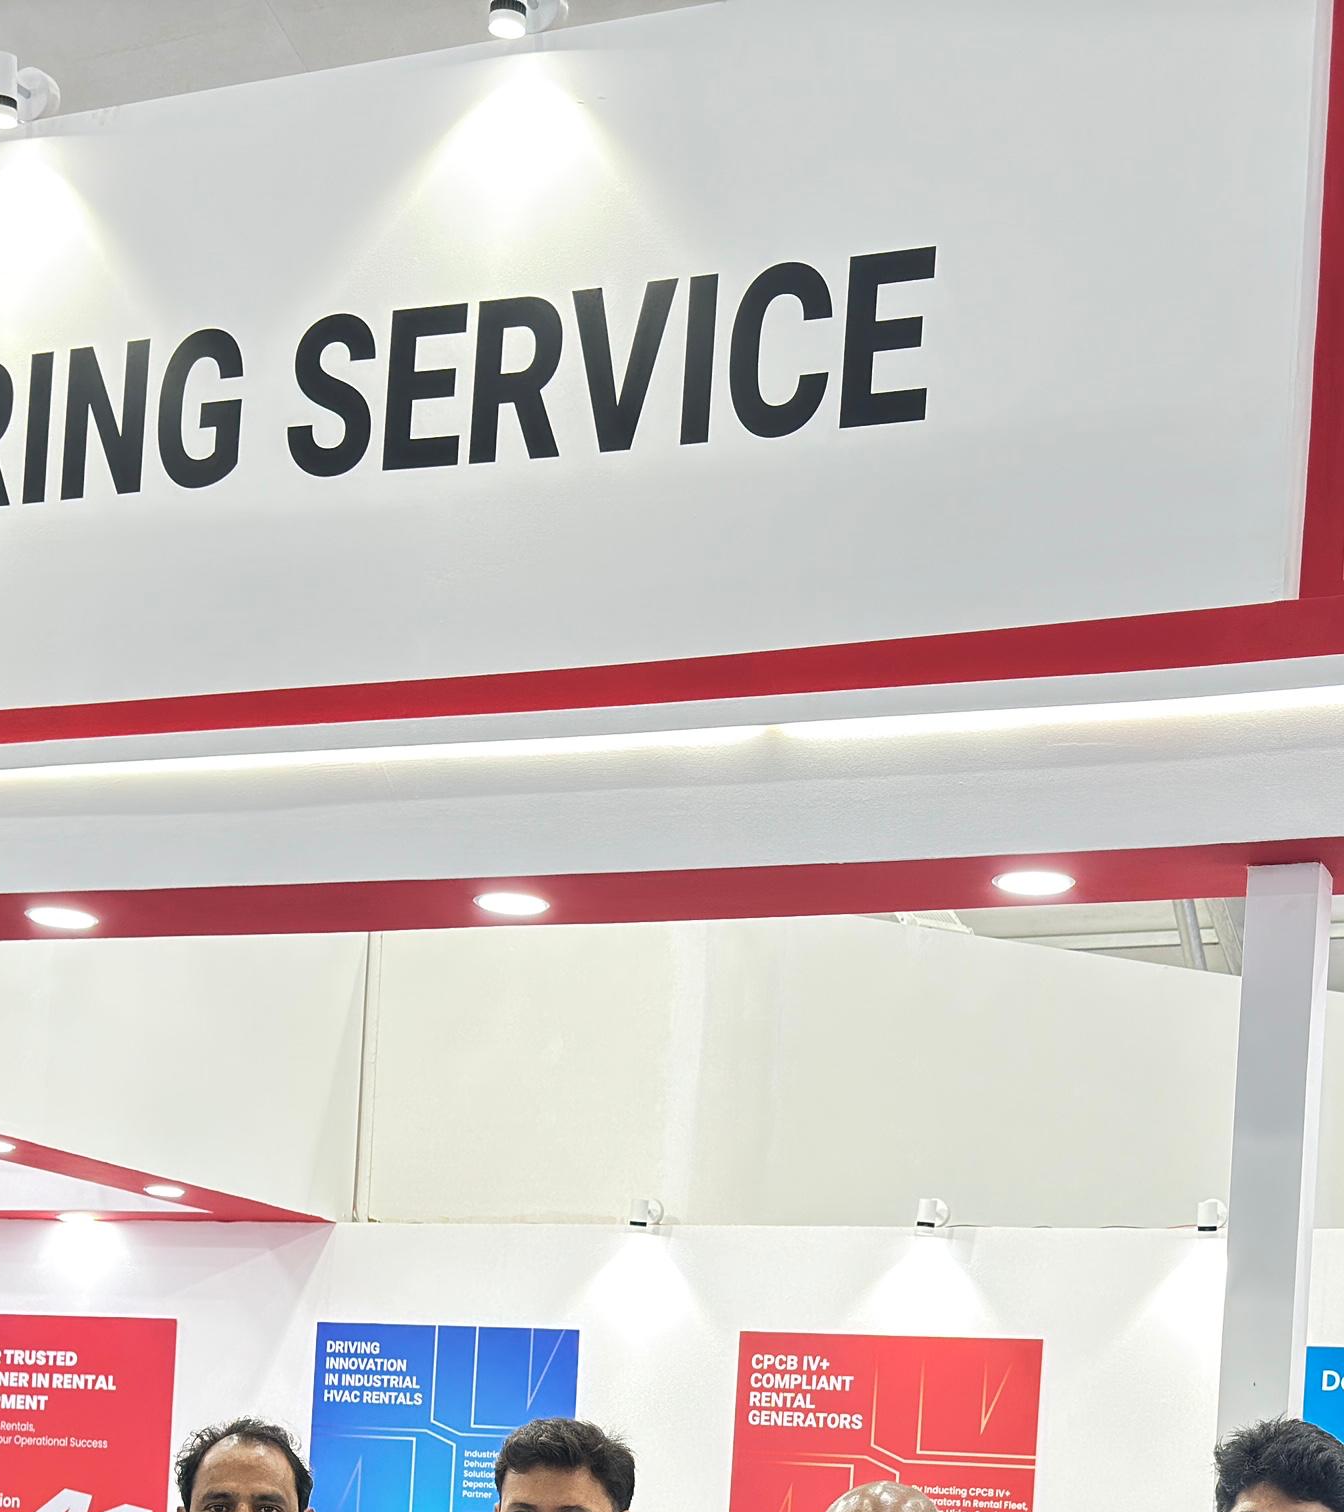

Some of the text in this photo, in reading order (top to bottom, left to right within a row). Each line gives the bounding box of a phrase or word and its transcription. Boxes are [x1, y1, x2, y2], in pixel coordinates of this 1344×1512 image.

[287, 245, 937, 478] SERVICE
[326, 1340, 380, 1354] DRIVING
[4, 1350, 78, 1367] TRUSTED
[325, 1357, 407, 1372] INNOVATION
[751, 1354, 830, 1371] CPCB IV+
[32, 1372, 49, 1388] IN
[52, 1373, 116, 1391] RENTAL
[324, 1373, 420, 1389] IN INDUSTRIAL
[750, 1373, 854, 1392] COMPLIANT
[323, 1391, 423, 1406] HVAC RENTALS
[749, 1391, 815, 1410] RENTAL
[0, 1421, 35, 1433] Rentals,
[748, 1410, 863, 1430] GENERATORS
[14, 1435, 68, 1448] Operational
[70, 1437, 108, 1449] Success
[462, 1489, 492, 1499] Partner
[924, 1485, 994, 1498] Inducting CPCB
[972, 1500, 1028, 1512] Rental Fleet,
